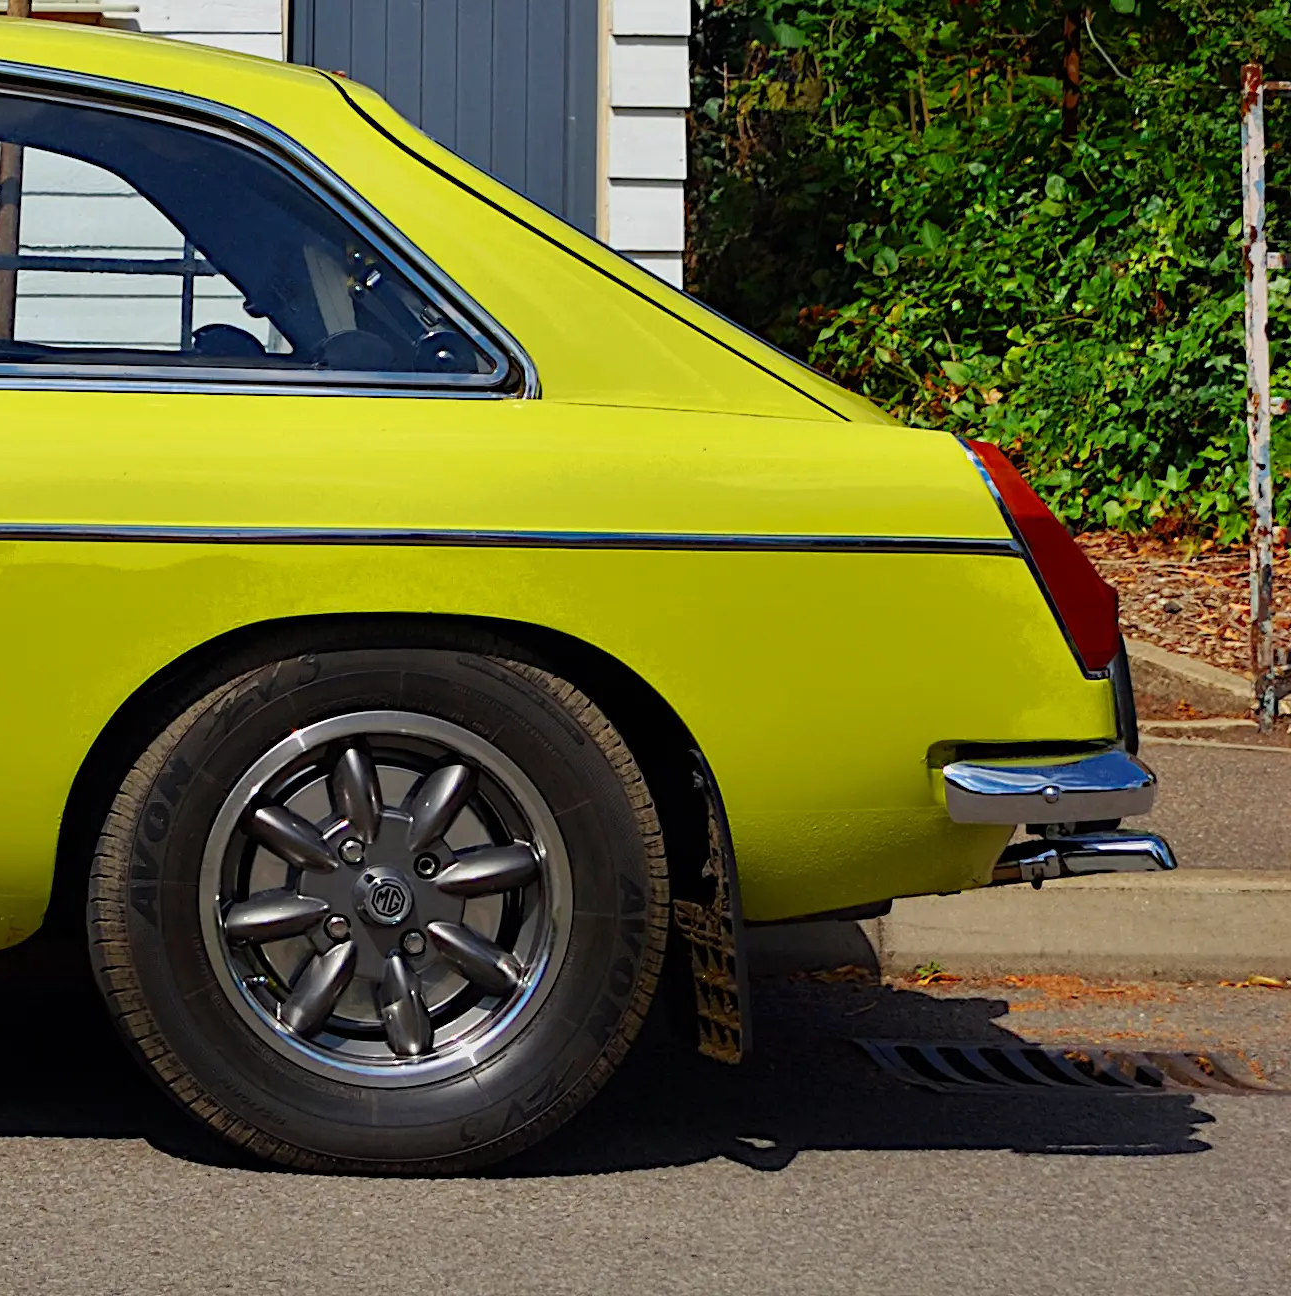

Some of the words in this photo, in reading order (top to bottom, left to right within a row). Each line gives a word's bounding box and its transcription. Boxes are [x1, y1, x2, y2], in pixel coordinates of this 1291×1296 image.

[130, 759, 193, 927] AVON
[374, 886, 402, 914] MG
[587, 873, 646, 1049] AVON
